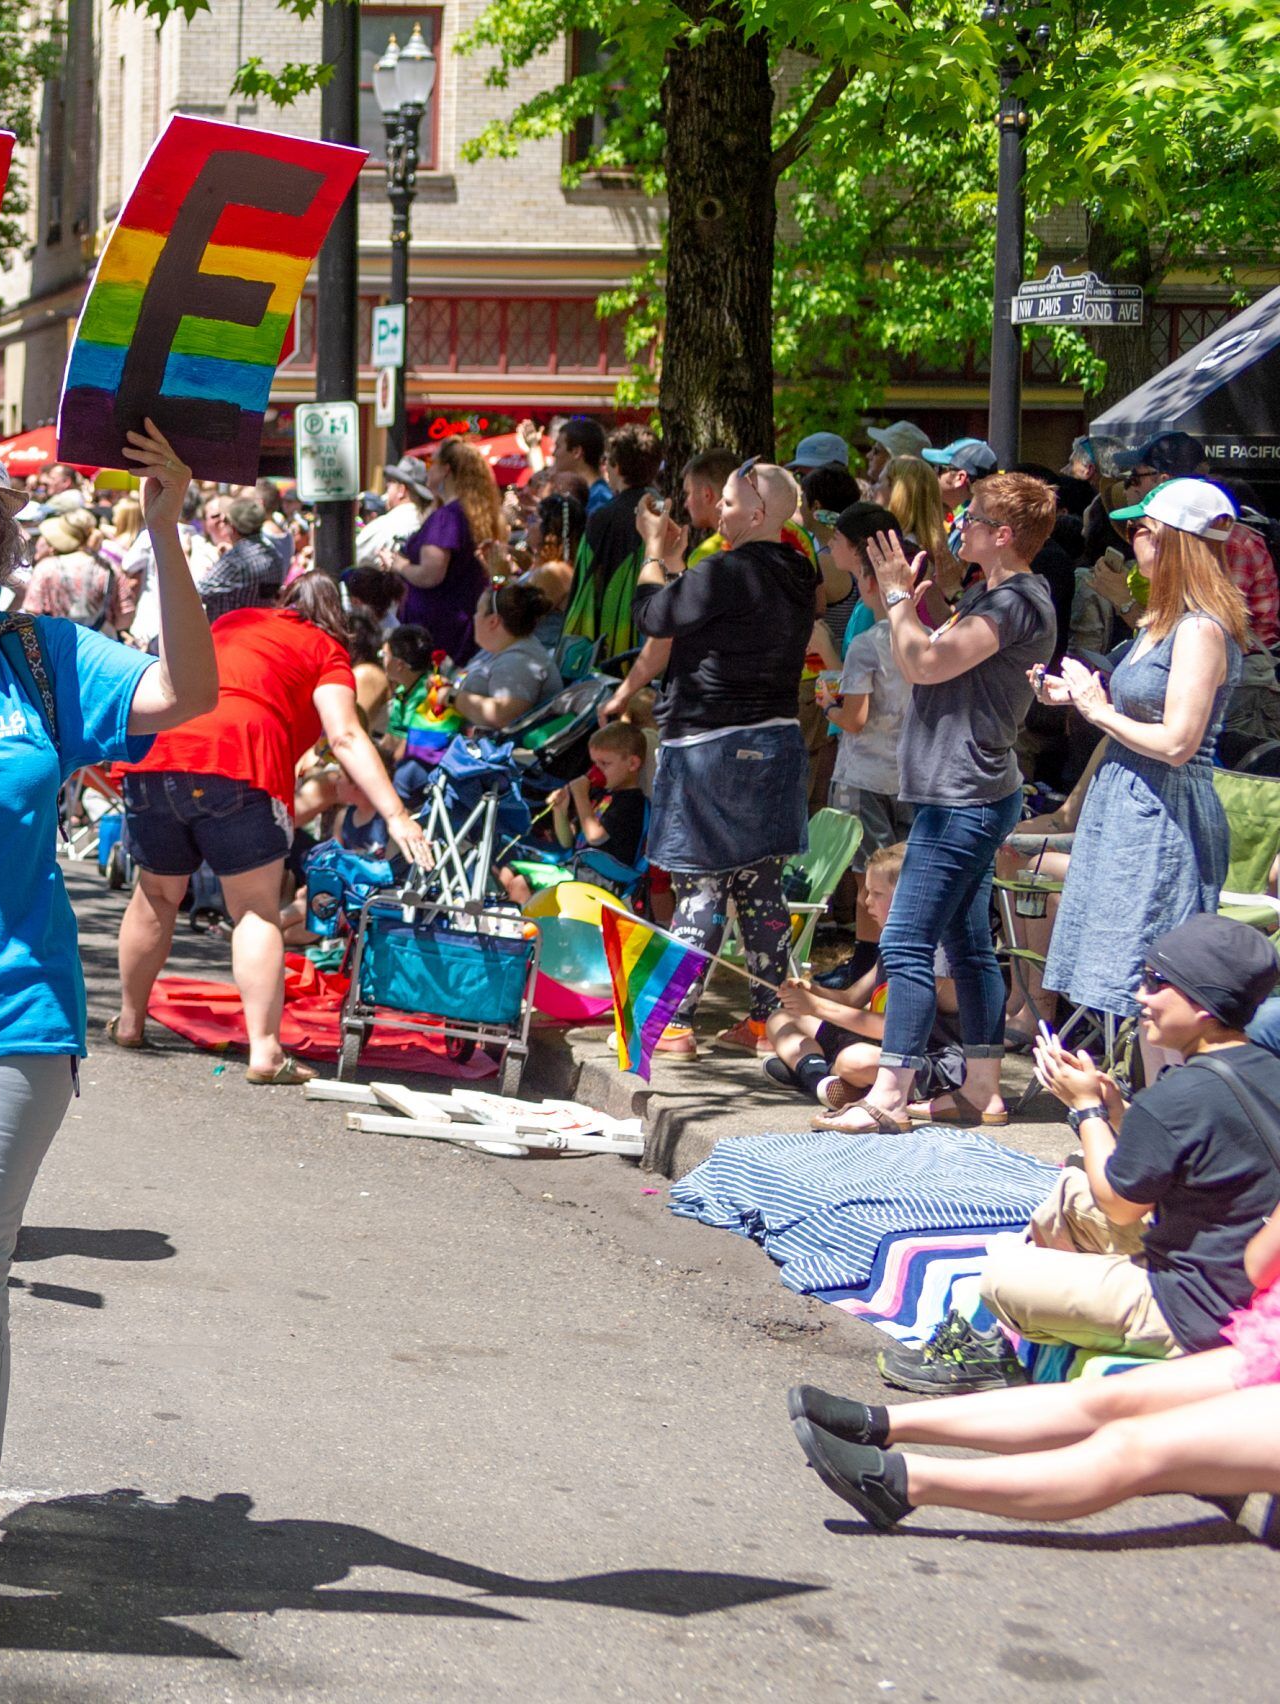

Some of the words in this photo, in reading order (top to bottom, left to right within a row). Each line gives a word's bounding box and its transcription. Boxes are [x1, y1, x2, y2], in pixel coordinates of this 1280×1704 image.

[1019, 299, 1034, 318] NW
[1038, 297, 1062, 317] DAVIS
[1072, 294, 1084, 314] ST
[1084, 302, 1113, 321] OND
[1117, 303, 1139, 320] AVE
[317, 445, 337, 455] PAY
[1204, 444, 1226, 458] NE
[1230, 444, 1280, 458] PACIFIC
[320, 457, 337, 467] TO
[313, 469, 344, 479] PARK
